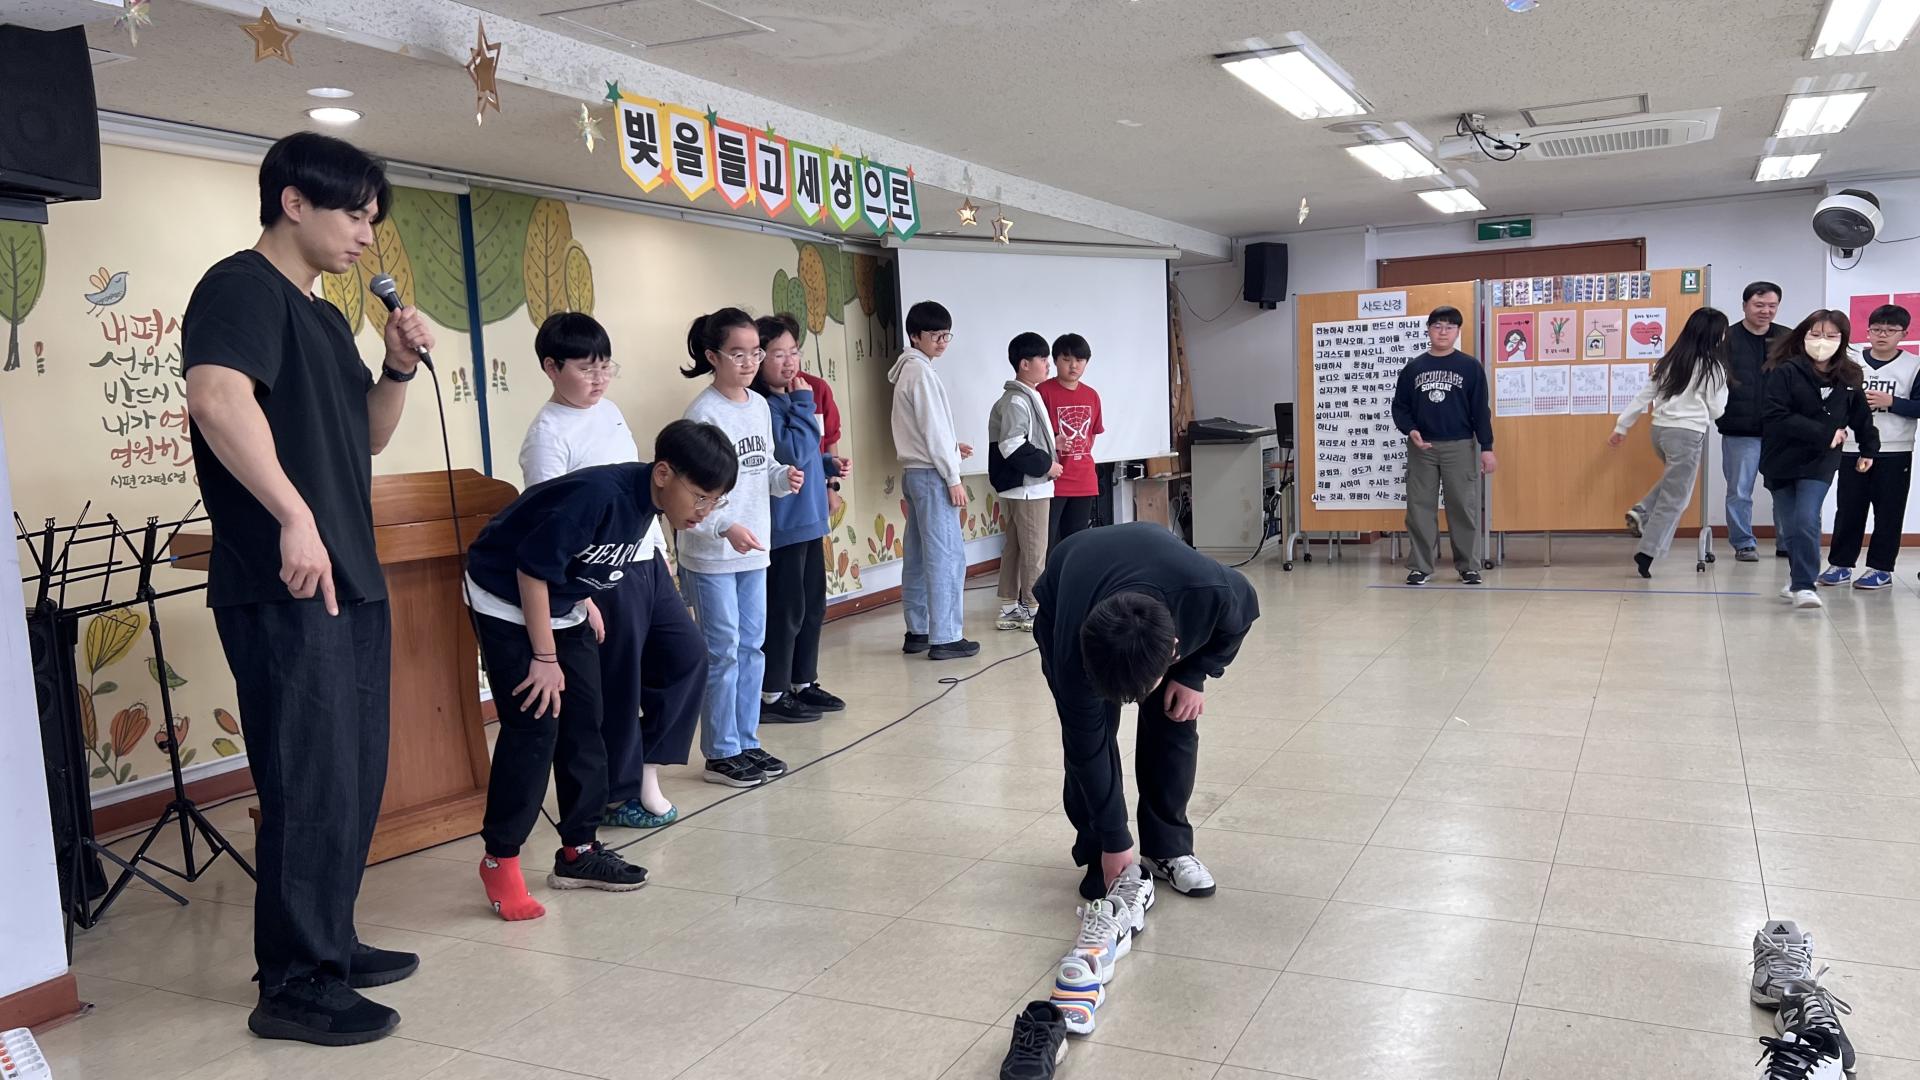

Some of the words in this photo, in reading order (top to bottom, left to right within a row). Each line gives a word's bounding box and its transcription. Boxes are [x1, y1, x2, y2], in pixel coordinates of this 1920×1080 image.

[624, 109, 703, 178] 빛을
[718, 132, 784, 195] 들고
[1362, 299, 1402, 312] 사도신경
[1316, 327, 1343, 335] 전능하사
[1348, 324, 1368, 332] 천지를
[1373, 321, 1393, 330] 만드신
[1399, 321, 1419, 329] 하나님
[1318, 339, 1331, 347] 내가
[1379, 335, 1399, 343] 외아들
[1405, 331, 1419, 339] 우리
[1317, 350, 1350, 358] 그리스도를
[1391, 345, 1404, 353] 이는
[1315, 362, 1342, 370] 잉태하사
[1353, 361, 1374, 370] 동정녀
[1319, 374, 1340, 382] 본디오
[1344, 372, 1379, 380] 빌라도에게
[1319, 386, 1346, 394] 십자가에
[1421, 382, 1452, 392] SOMEDAY
[102, 410, 156, 436] 내가
[1318, 423, 1338, 432] 하나님
[1348, 428, 1368, 436] 우편에
[1376, 424, 1389, 432] 앉아
[1361, 439, 1375, 447] 자와
[1351, 465, 1371, 475] 성도가
[1379, 464, 1392, 472] 서로
[1340, 479, 1360, 488] 사하여
[1369, 479, 1389, 487] 주시는
[1376, 491, 1390, 499] 사는
